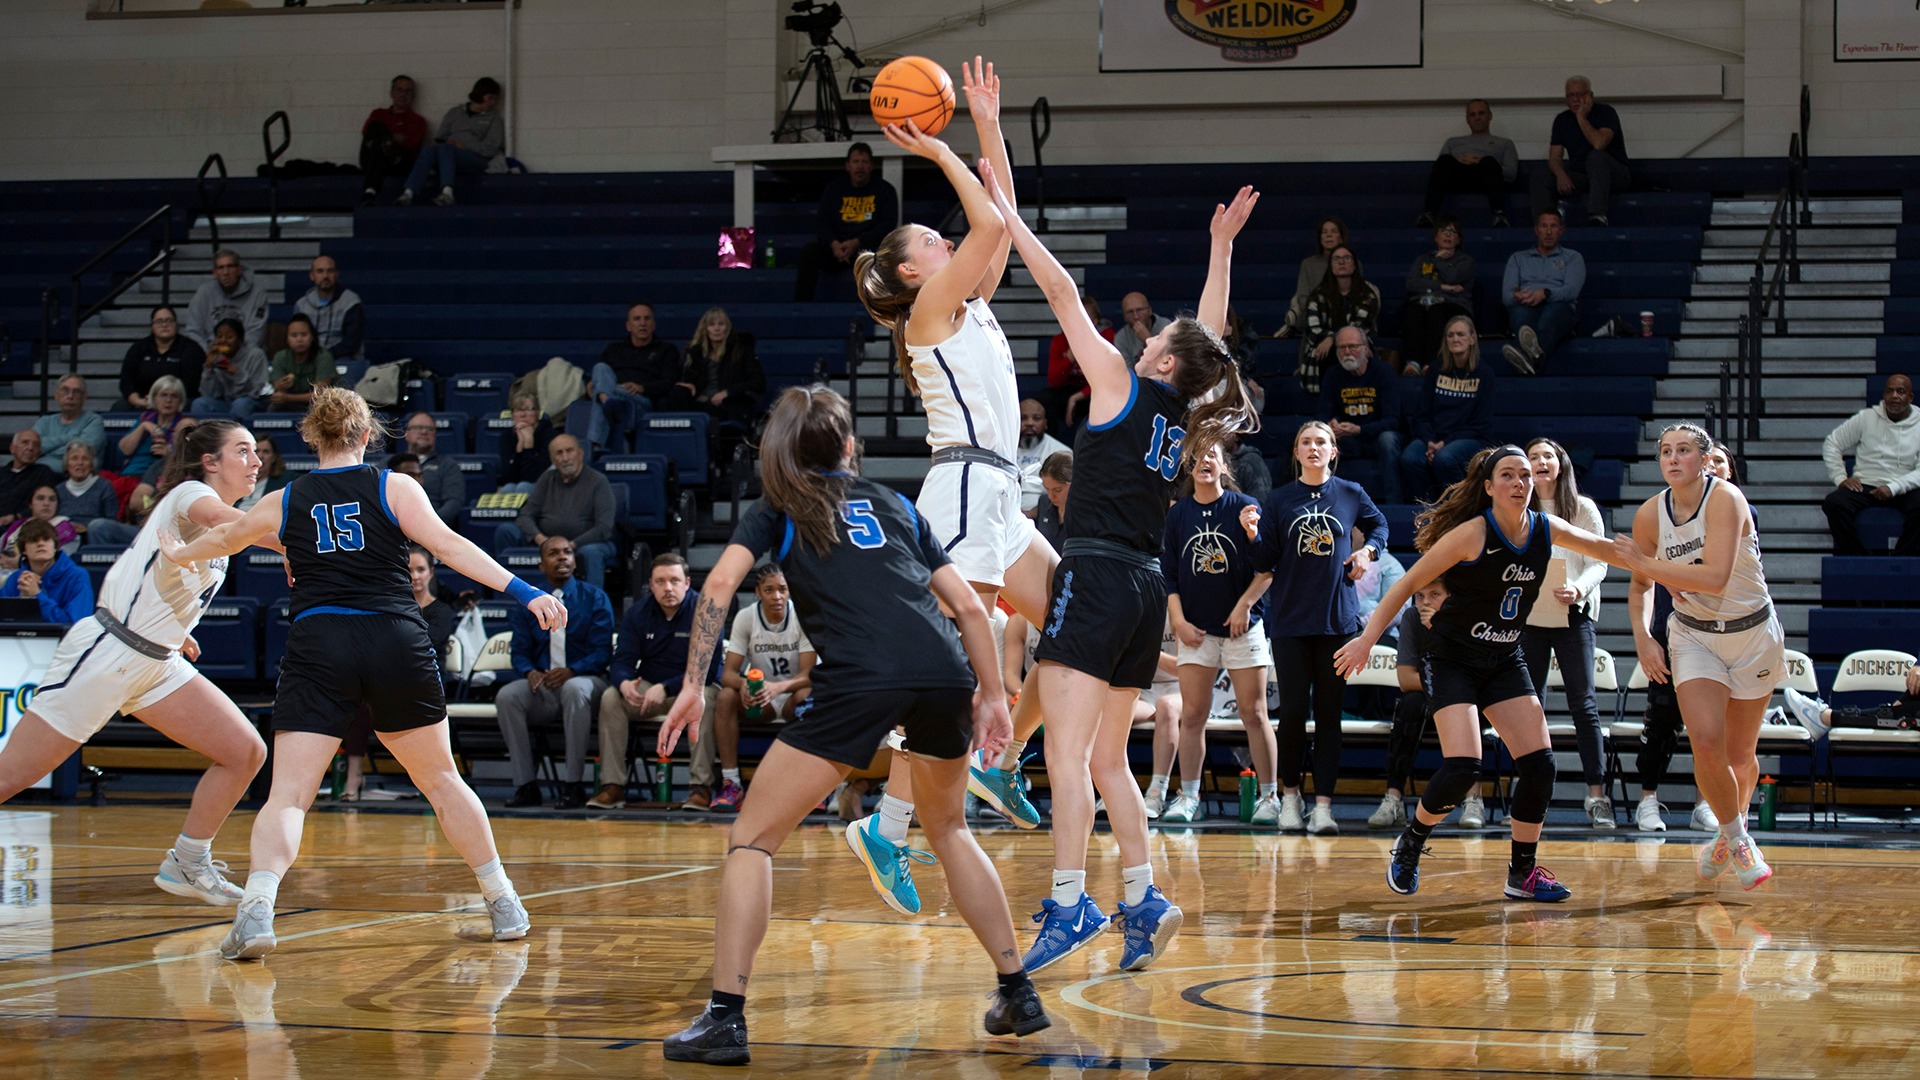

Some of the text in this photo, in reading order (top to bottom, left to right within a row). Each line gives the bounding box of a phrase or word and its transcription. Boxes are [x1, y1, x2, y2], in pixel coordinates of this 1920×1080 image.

[1205, 2, 1315, 28] WELDING
[1217, 37, 1240, 47] SINCE
[1842, 43, 1879, 55] Experience
[1880, 42, 1894, 52] The
[873, 95, 899, 109] EVO
[1436, 374, 1480, 392] CEDARVILLE
[253, 419, 292, 428] RESERVED
[649, 419, 691, 428] RESERVED
[1144, 413, 1187, 482] 13
[605, 462, 648, 471] RESERVED
[470, 509, 518, 518] RESERVED
[310, 502, 365, 553] 15
[839, 499, 887, 549] 5
[1501, 563, 1536, 582] Ohio
[1499, 586, 1523, 620] 0
[770, 657, 790, 677] 12
[1846, 658, 1915, 677] JACKETS
